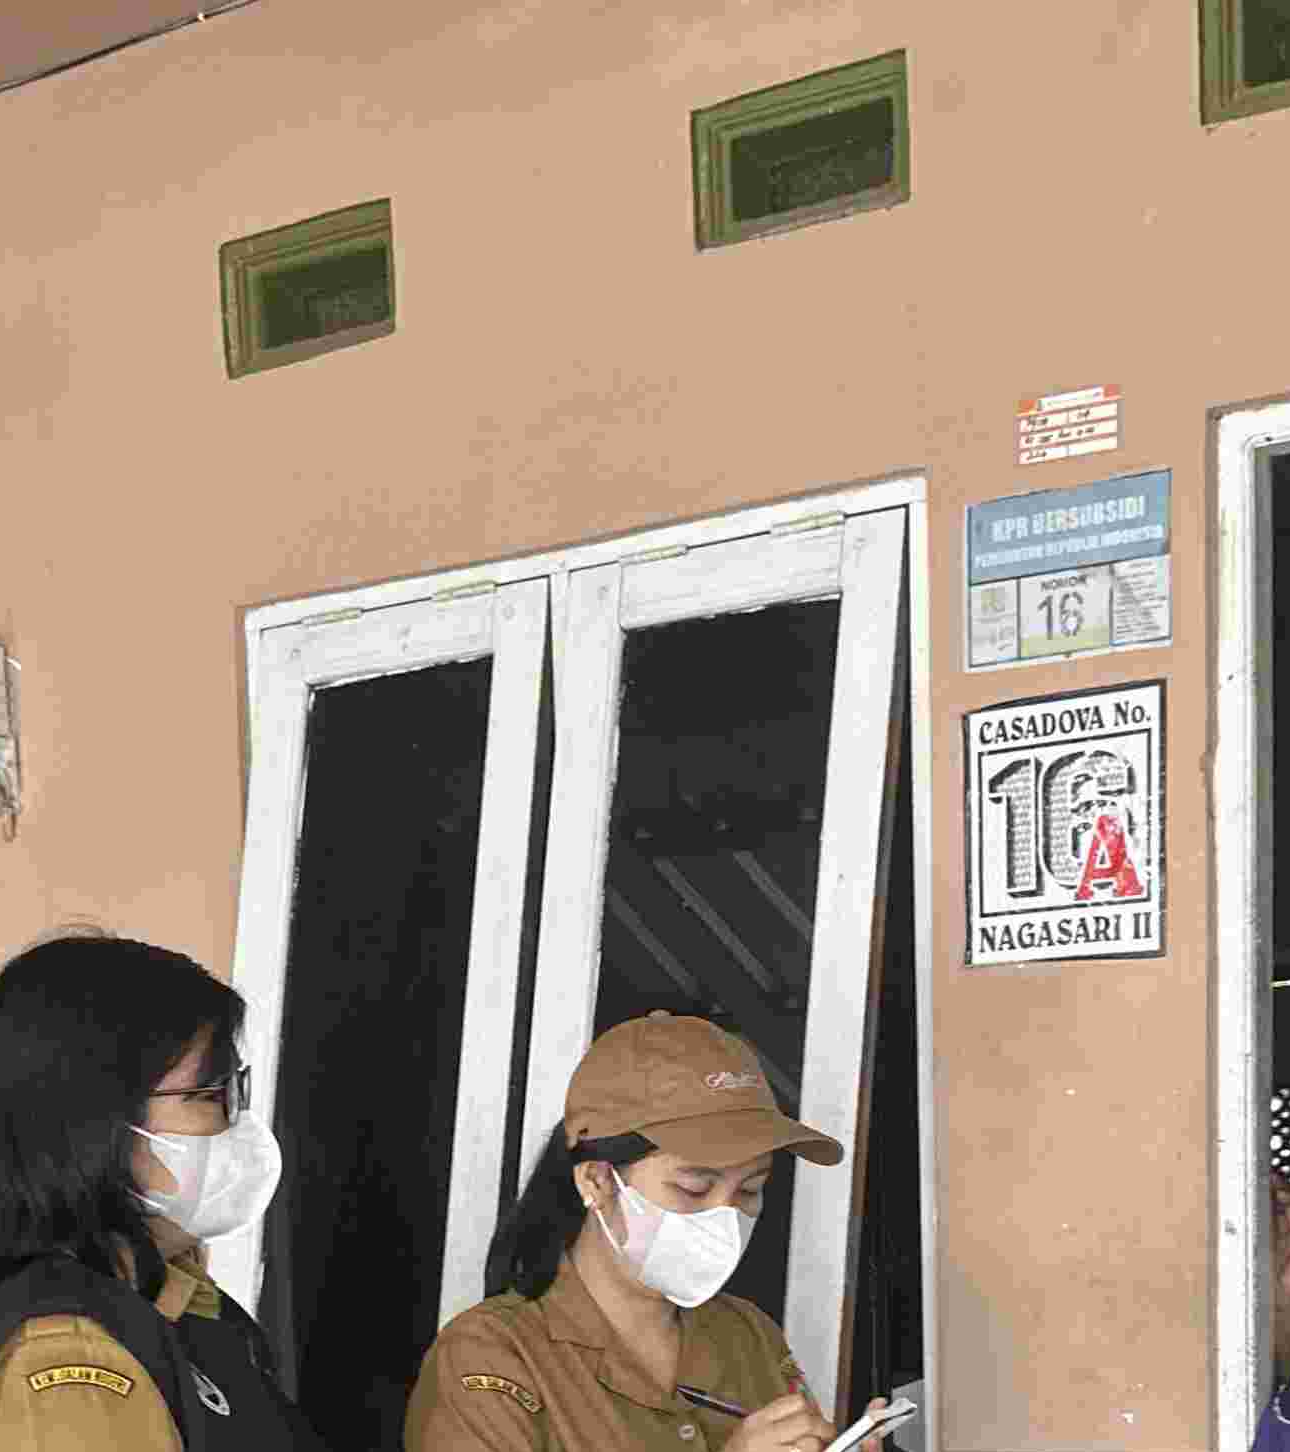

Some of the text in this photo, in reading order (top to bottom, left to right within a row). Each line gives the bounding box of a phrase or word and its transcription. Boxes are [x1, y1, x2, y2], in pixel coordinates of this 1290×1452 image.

[991, 496, 1145, 542] KPR BERSUBSIDI
[1037, 592, 1085, 640] 16
[978, 700, 1152, 745] CASADOVA No.
[979, 914, 1121, 953] NAGASARI
